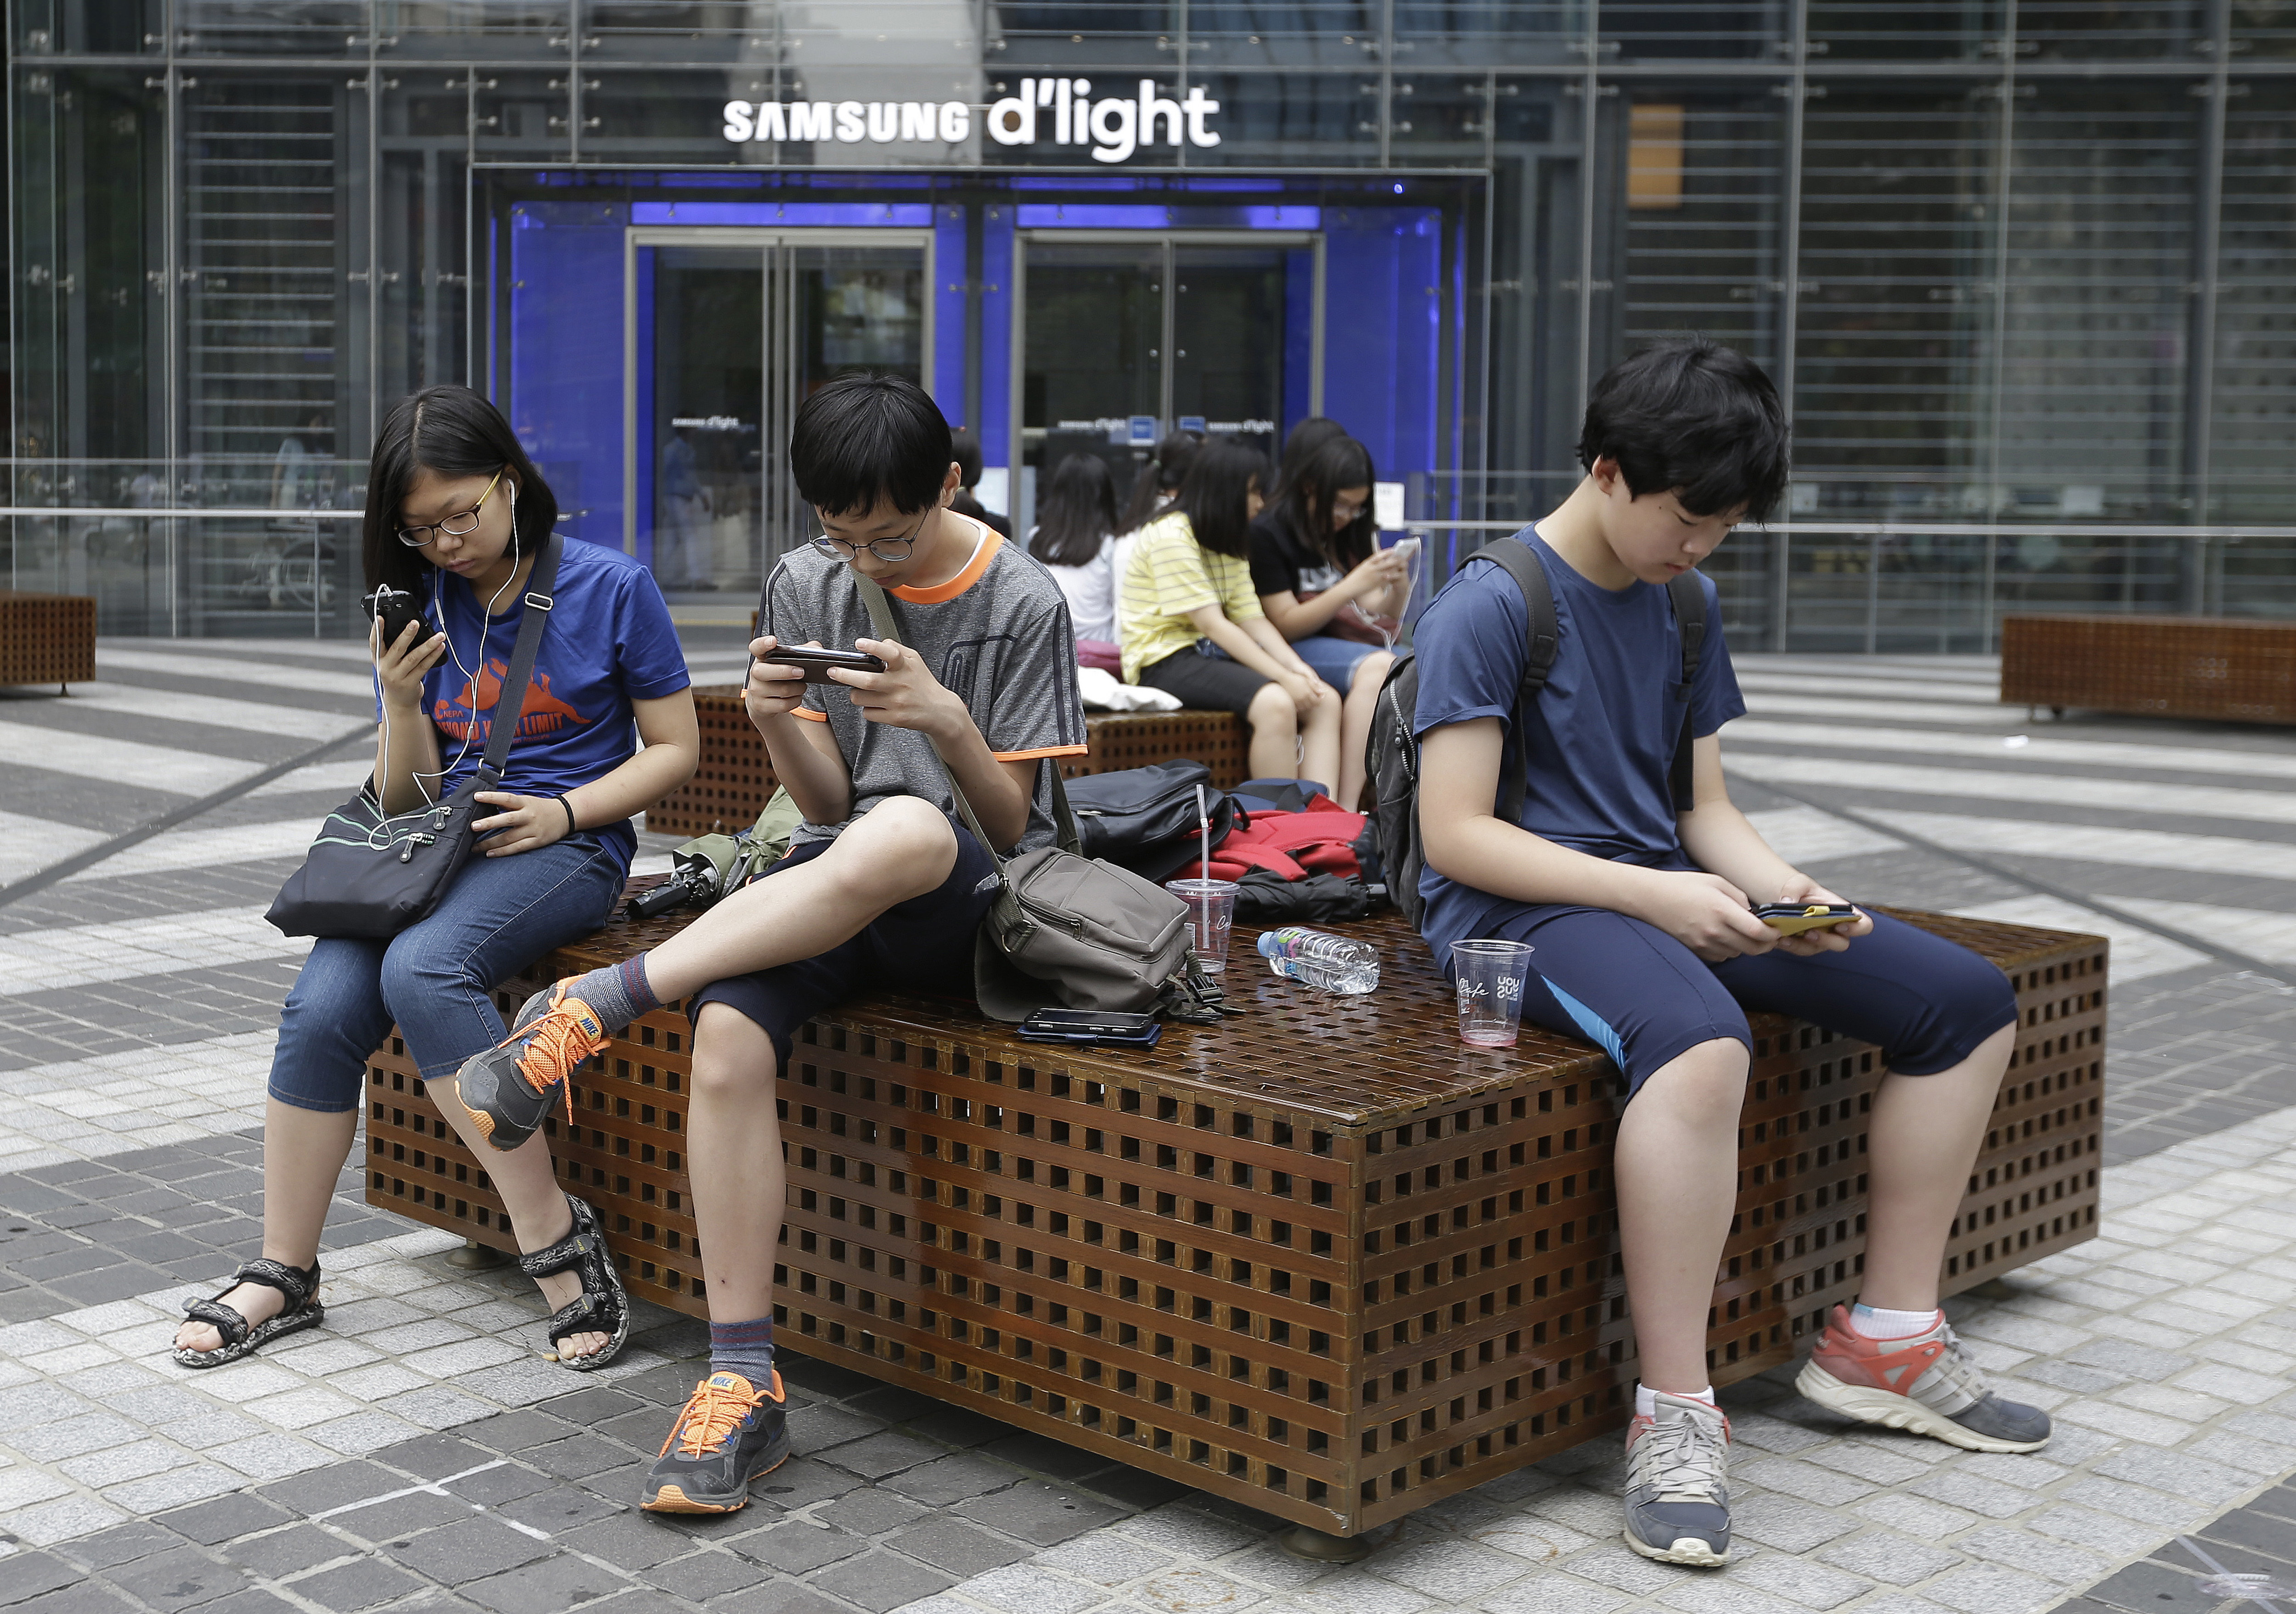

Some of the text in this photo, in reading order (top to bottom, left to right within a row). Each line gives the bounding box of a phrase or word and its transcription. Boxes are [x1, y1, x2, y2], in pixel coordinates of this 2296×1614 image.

[723, 77, 1221, 163] SAMSUNG d'light
[523, 713, 563, 735] LIMIT
[580, 1017, 599, 1036] NIKE
[710, 1377, 734, 1387] NIKE
